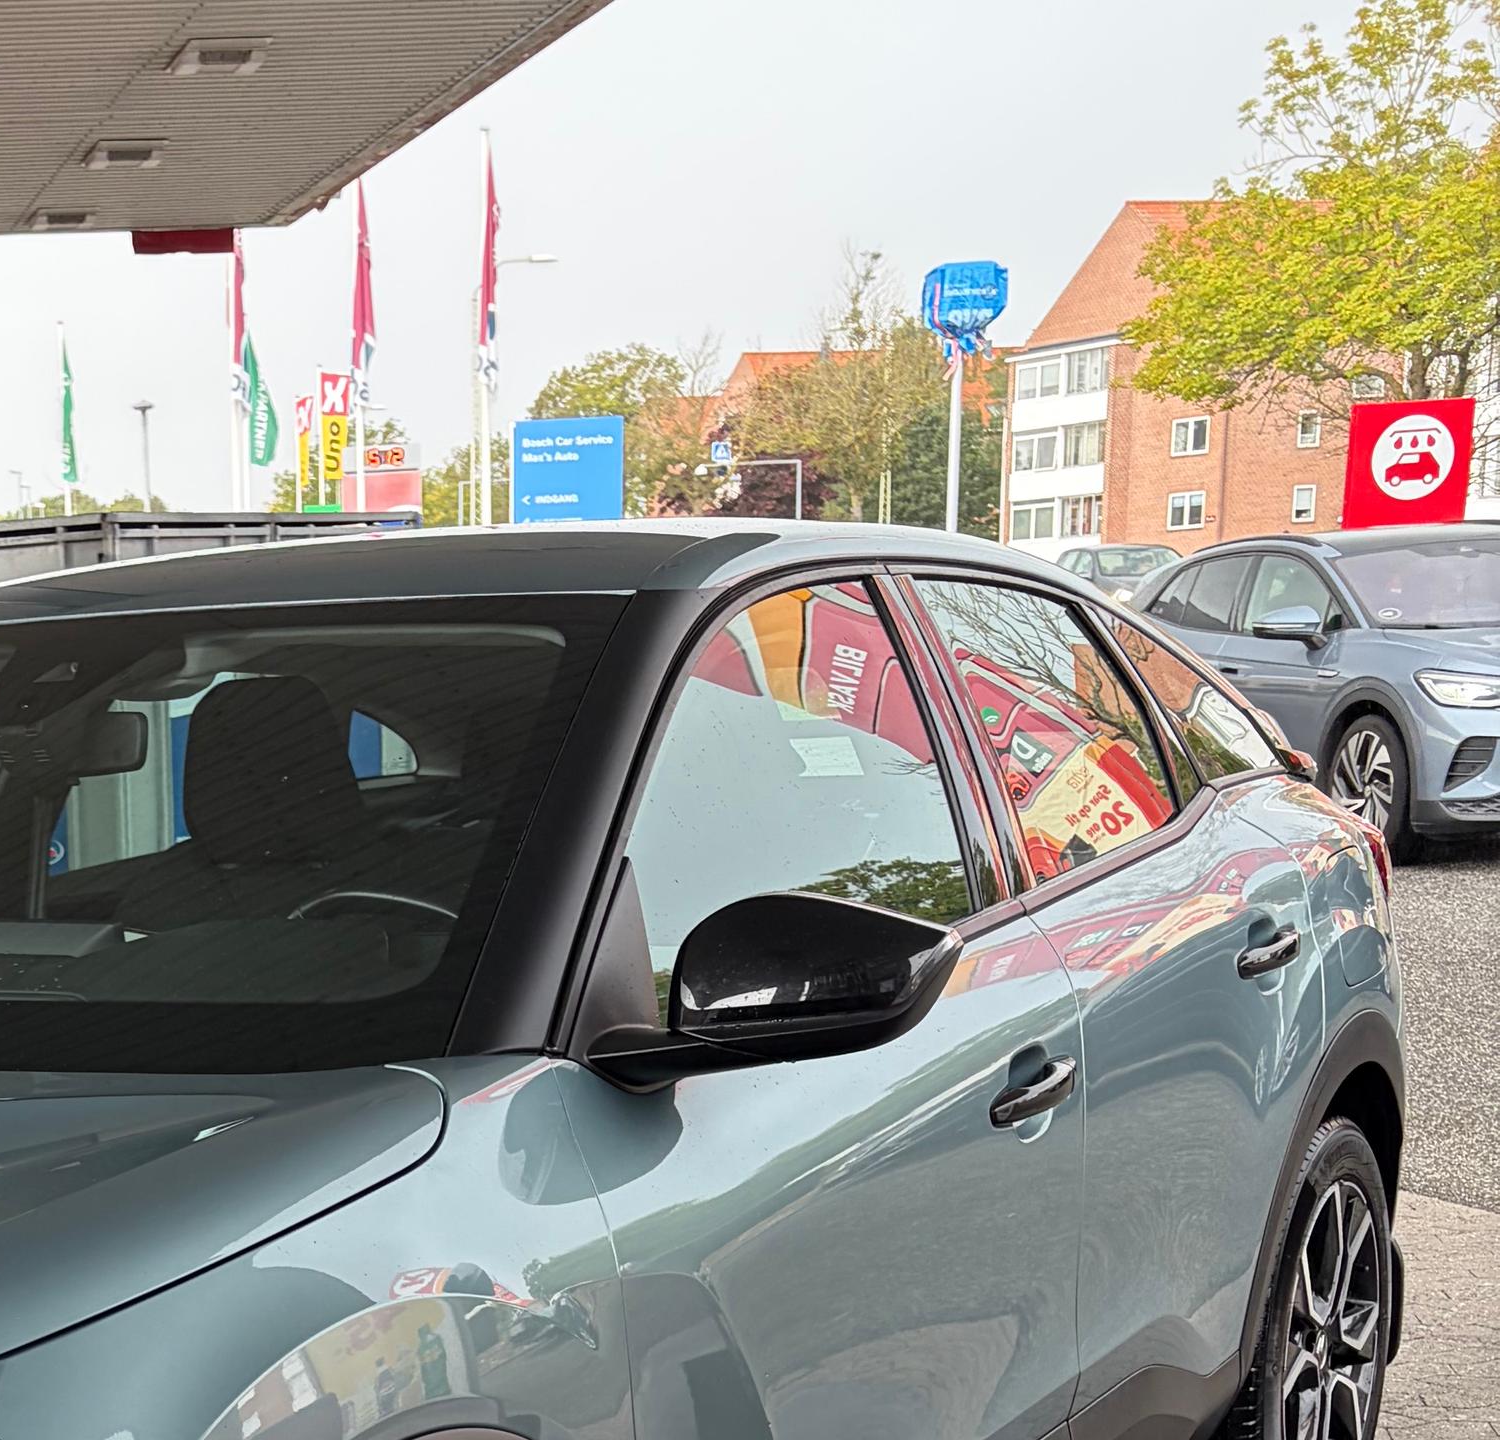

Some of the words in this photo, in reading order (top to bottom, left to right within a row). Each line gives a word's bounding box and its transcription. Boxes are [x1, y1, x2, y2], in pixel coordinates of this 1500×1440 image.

[555, 436, 574, 446] Car
[575, 434, 614, 446] Service
[554, 451, 580, 461] Auto
